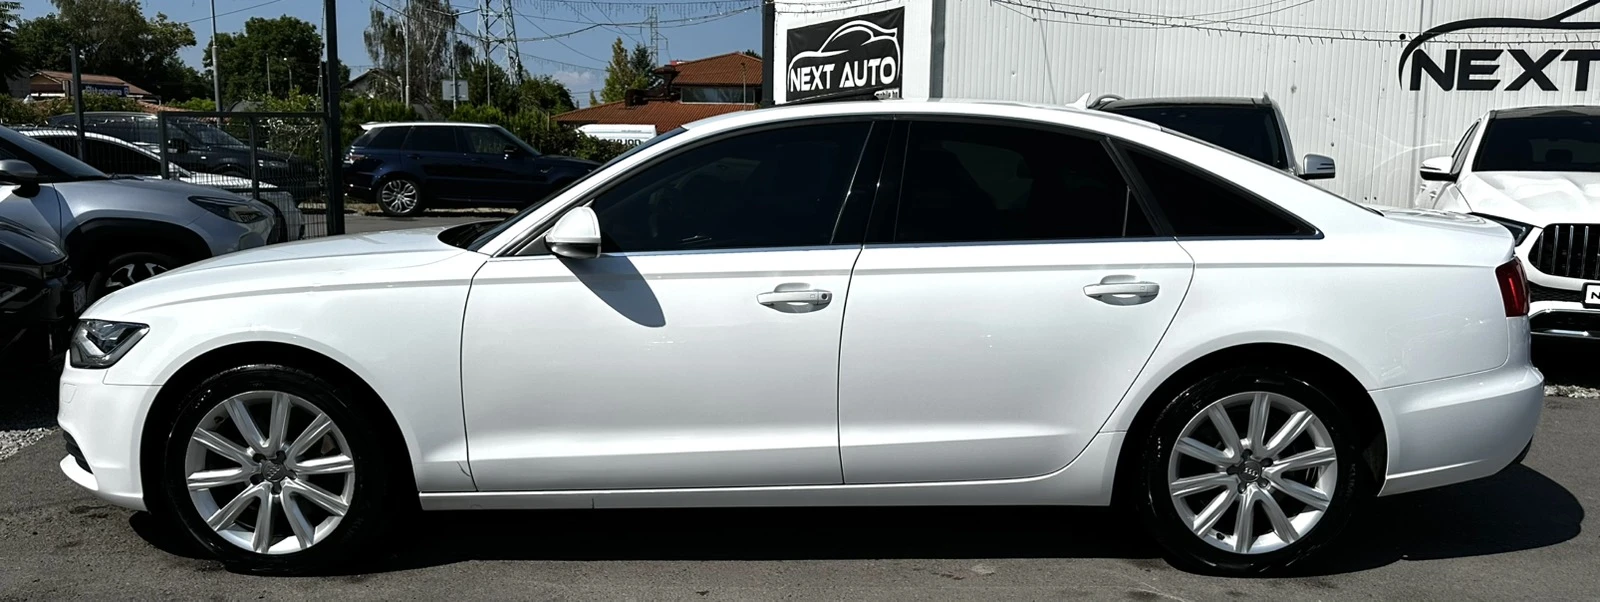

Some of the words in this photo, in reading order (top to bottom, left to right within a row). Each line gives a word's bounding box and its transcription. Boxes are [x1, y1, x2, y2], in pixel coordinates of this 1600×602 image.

[790, 63, 835, 92] NEXT
[839, 56, 896, 88] AUTO
[1410, 49, 1600, 91] NEXT
